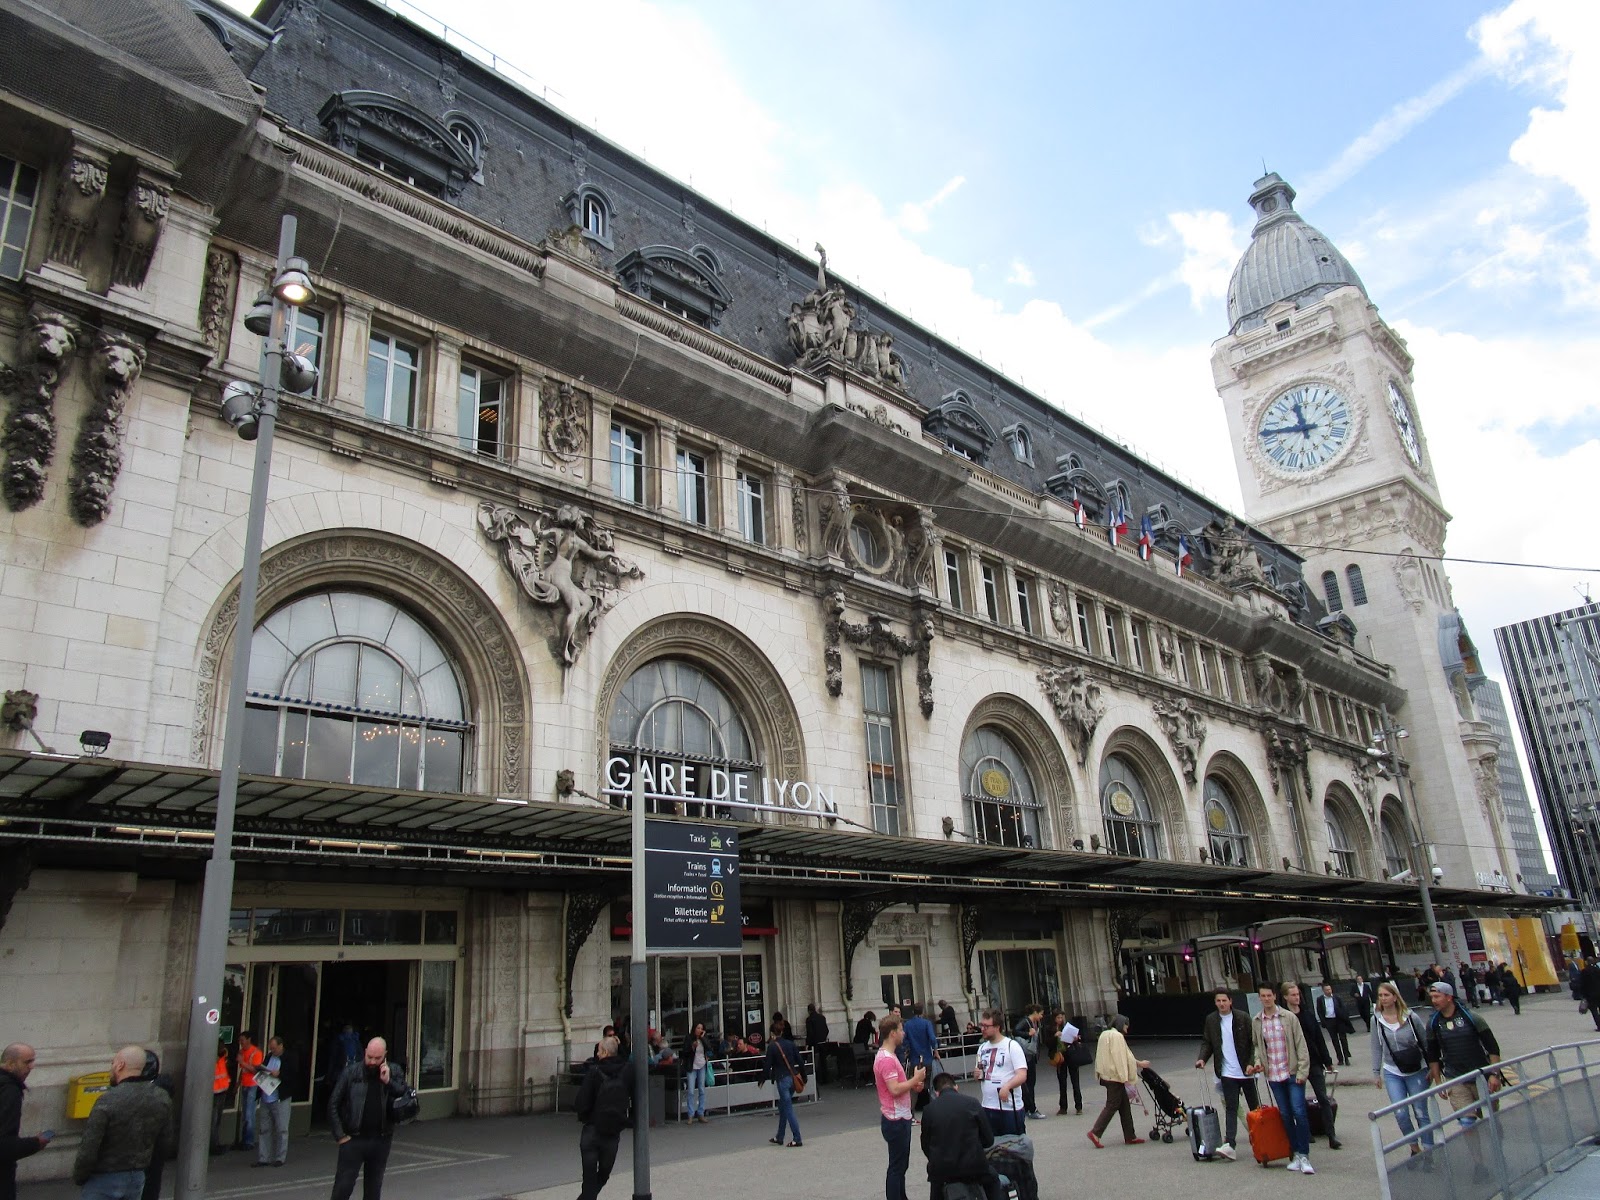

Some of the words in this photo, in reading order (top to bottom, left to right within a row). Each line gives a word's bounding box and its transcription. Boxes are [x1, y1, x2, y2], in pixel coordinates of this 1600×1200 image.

[604, 757, 696, 797] GARE
[710, 769, 749, 803] DE
[762, 776, 837, 814] LYON
[689, 834, 706, 844] Taxis
[687, 861, 707, 871] Trains
[667, 883, 707, 894] Information
[674, 907, 708, 917] Billetterie
